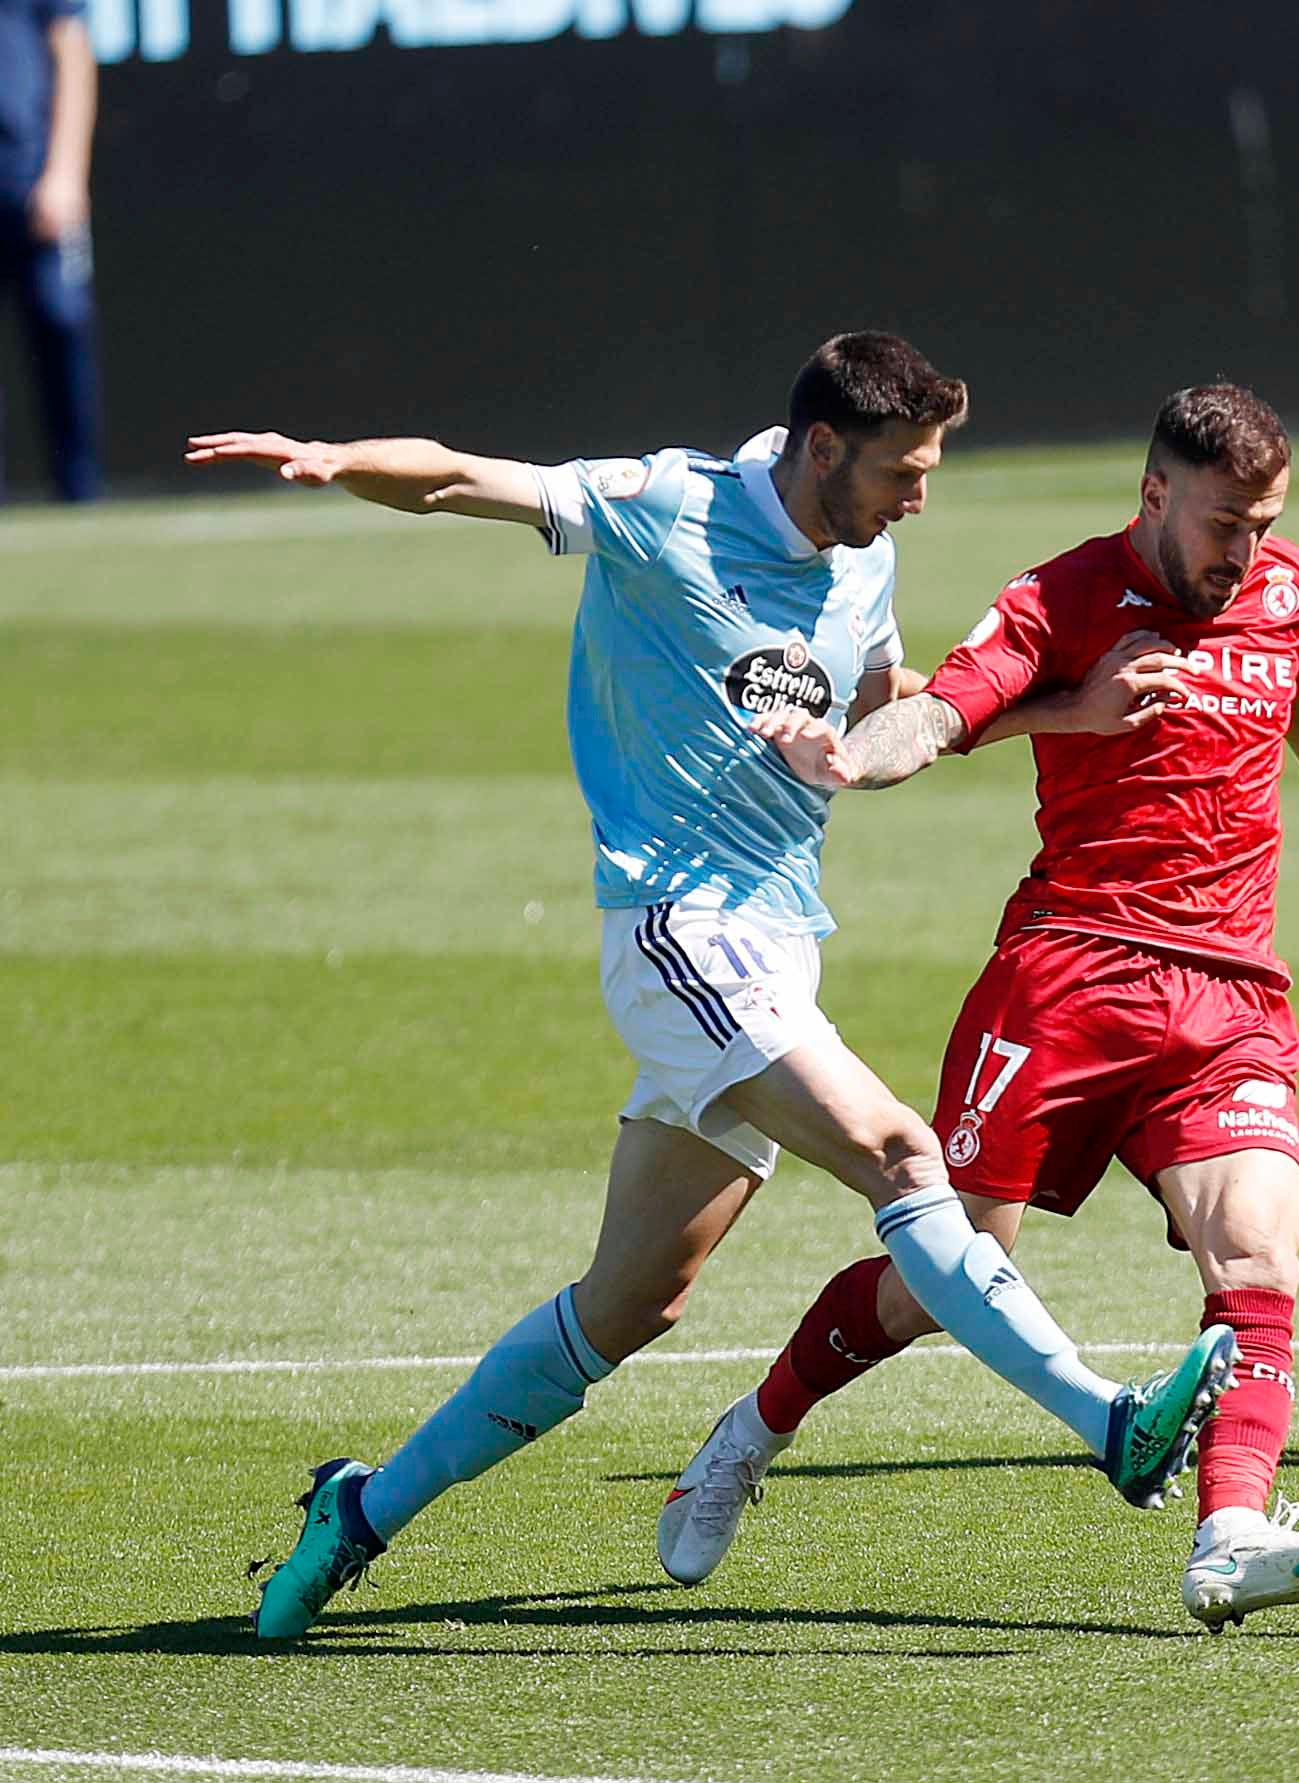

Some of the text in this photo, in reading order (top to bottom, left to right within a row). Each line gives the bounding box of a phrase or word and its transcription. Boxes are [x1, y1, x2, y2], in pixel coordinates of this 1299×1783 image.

[744, 656, 826, 704] Estrella
[1162, 646, 1294, 690] PIRE
[964, 1032, 1032, 1112] 17
